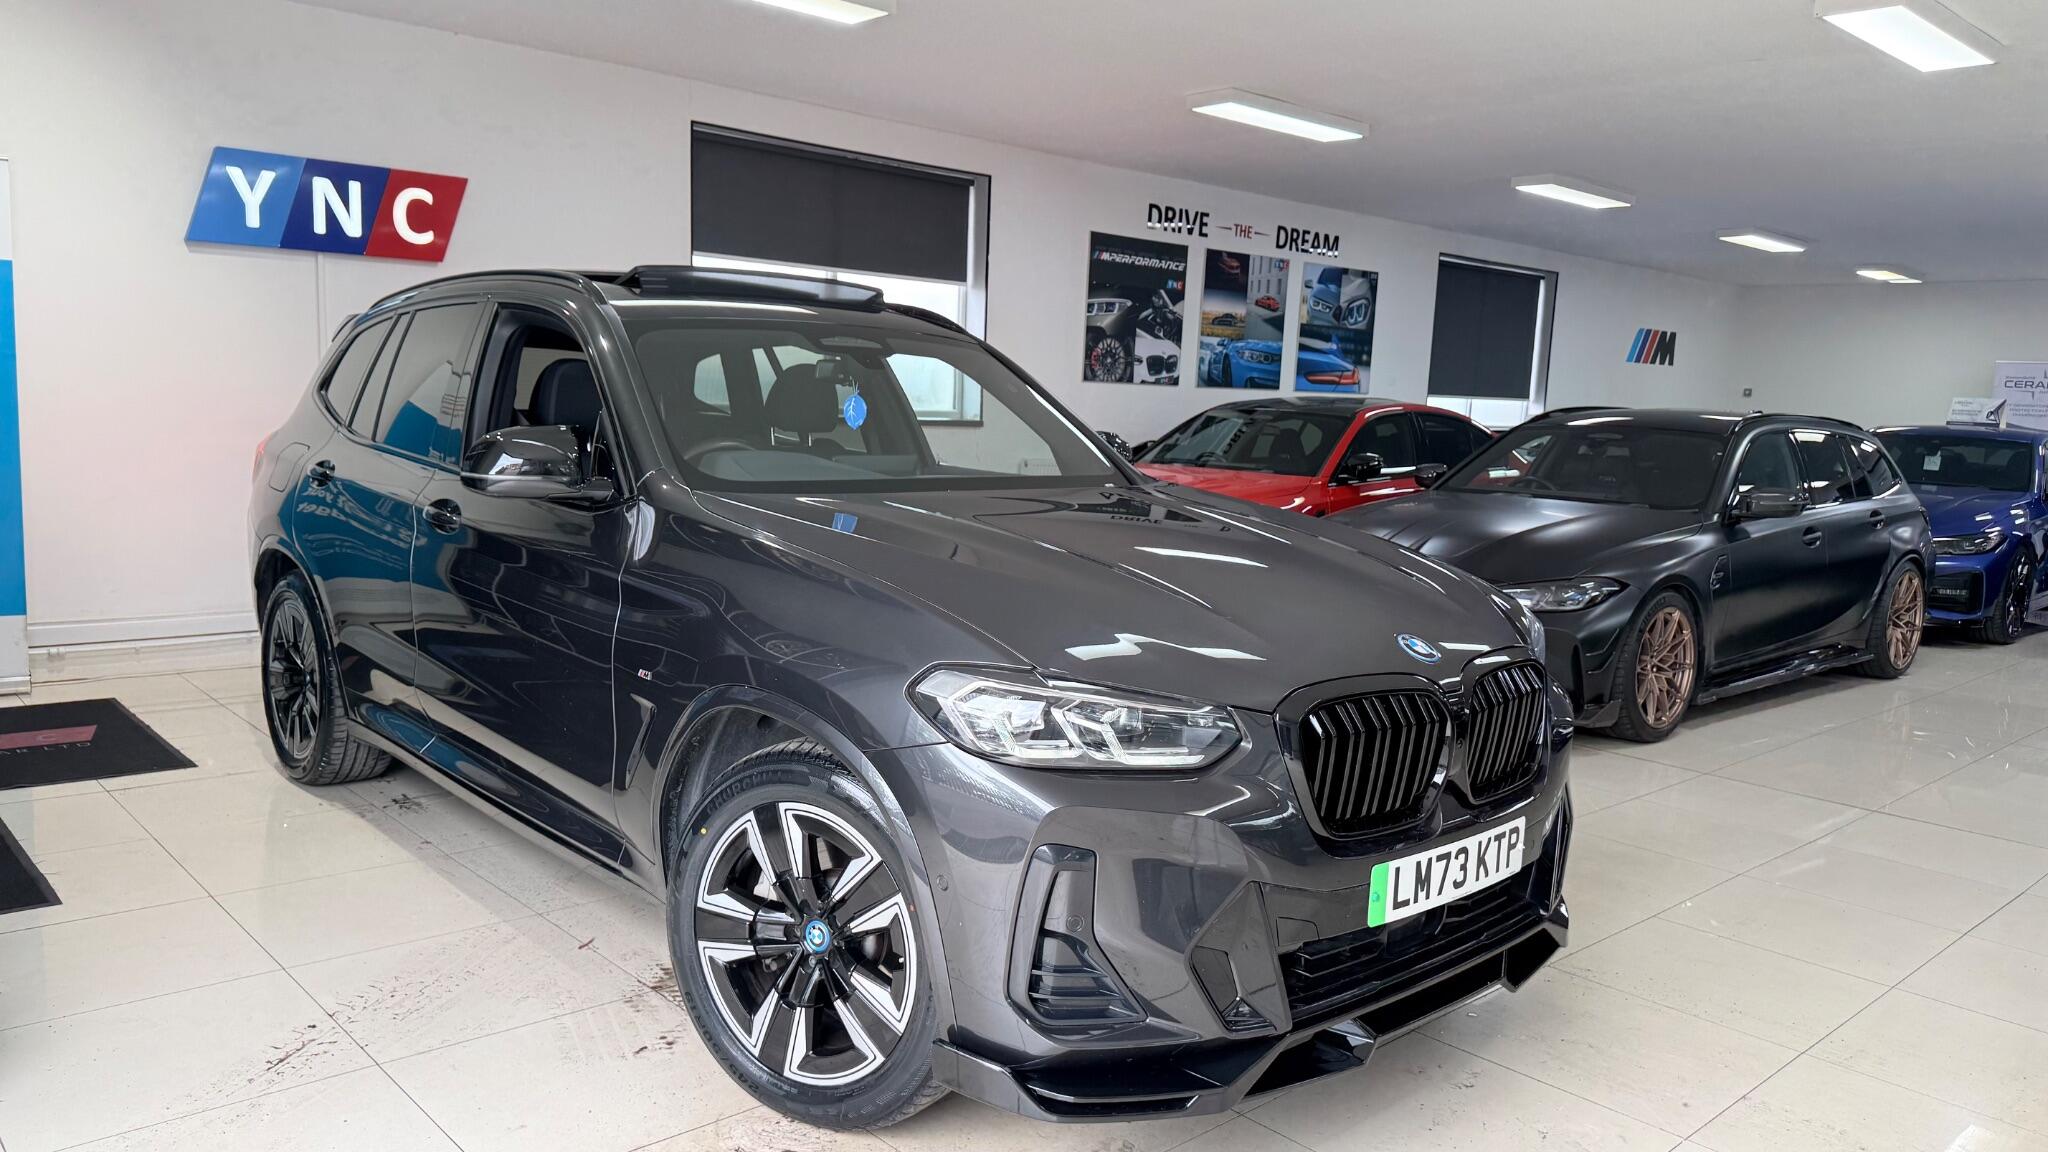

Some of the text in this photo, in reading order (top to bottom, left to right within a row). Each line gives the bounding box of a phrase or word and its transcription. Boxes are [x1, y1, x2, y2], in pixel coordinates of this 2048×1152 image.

[225, 165, 435, 245] YNC
[1147, 203, 1340, 258] DRIVE THE DREAM
[2004, 379, 2048, 389] CERA
[1392, 826, 1520, 911] LM73 KTP
